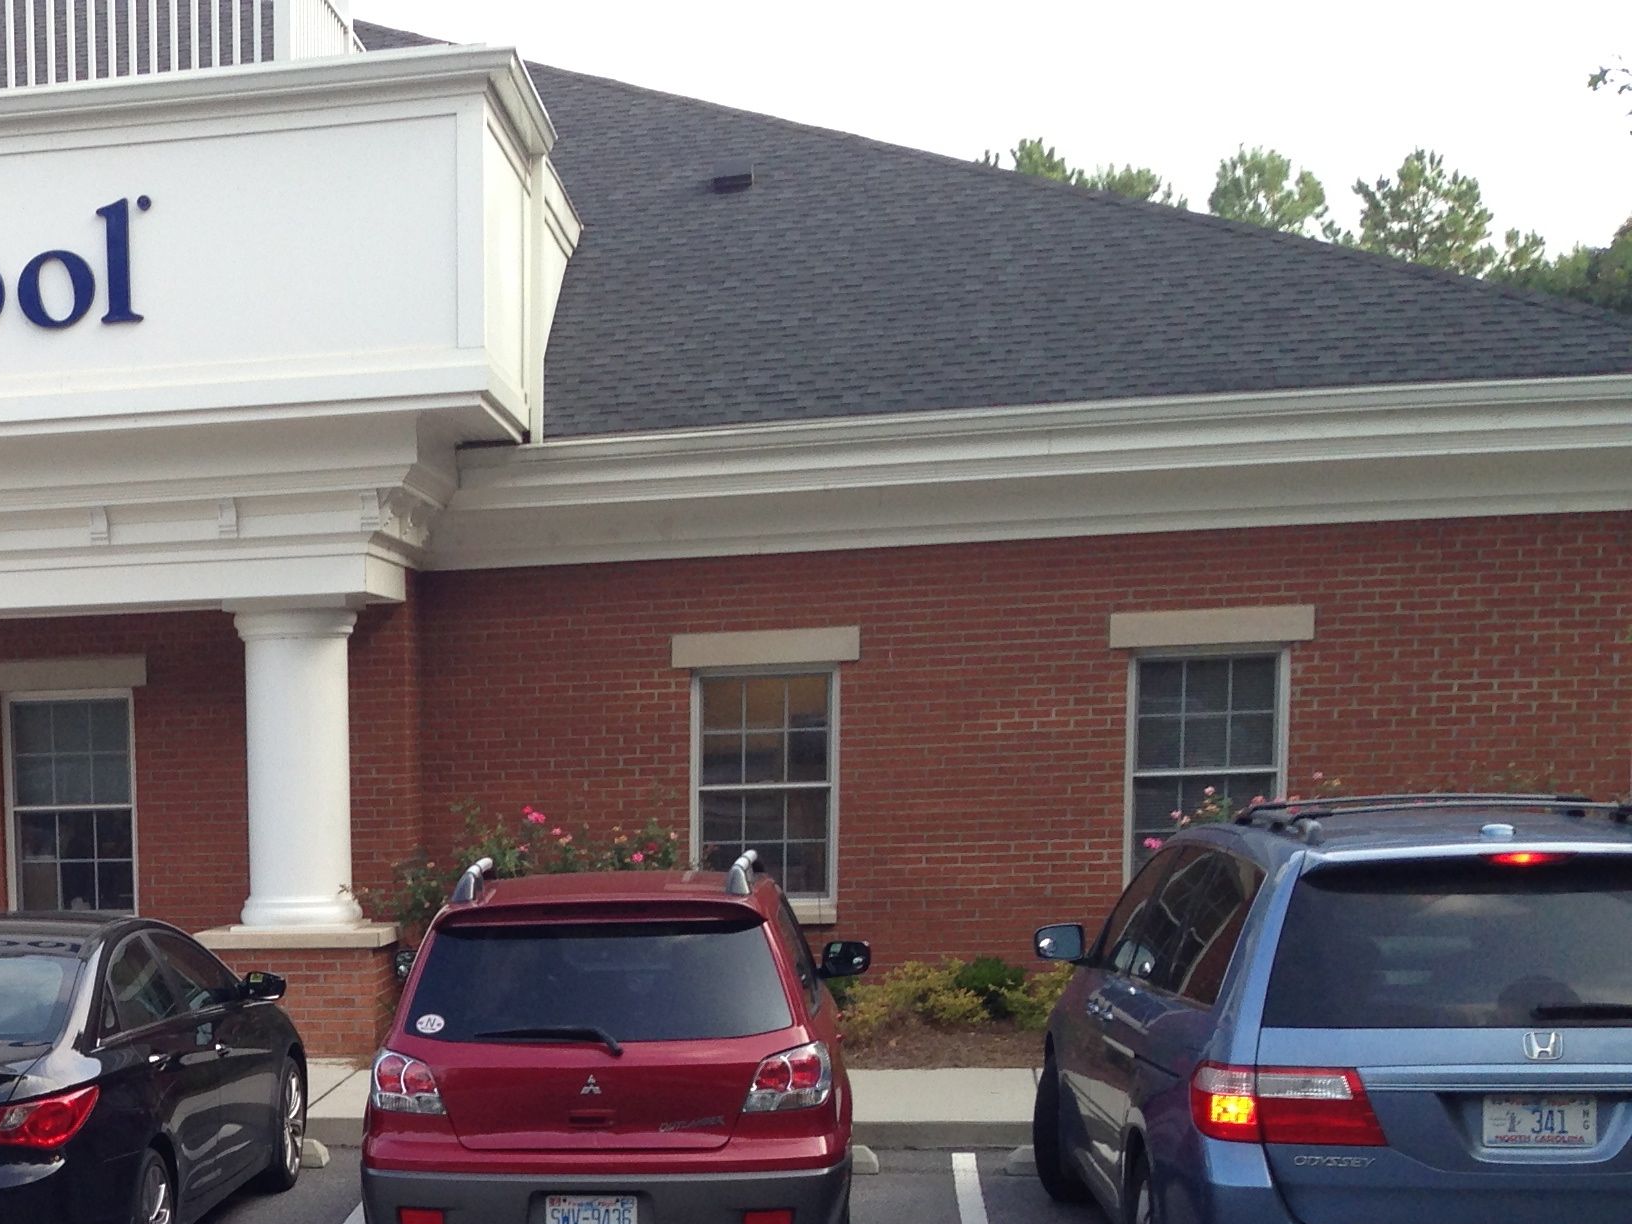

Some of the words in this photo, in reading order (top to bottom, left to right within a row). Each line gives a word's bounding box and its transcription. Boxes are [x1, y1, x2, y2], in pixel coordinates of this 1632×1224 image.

[1530, 1109, 1568, 1134] 341
[1494, 1134, 1531, 1143] NORTH
[1534, 1134, 1585, 1144] CAROLINA
[1294, 1155, 1376, 1167] ODYSSEY
